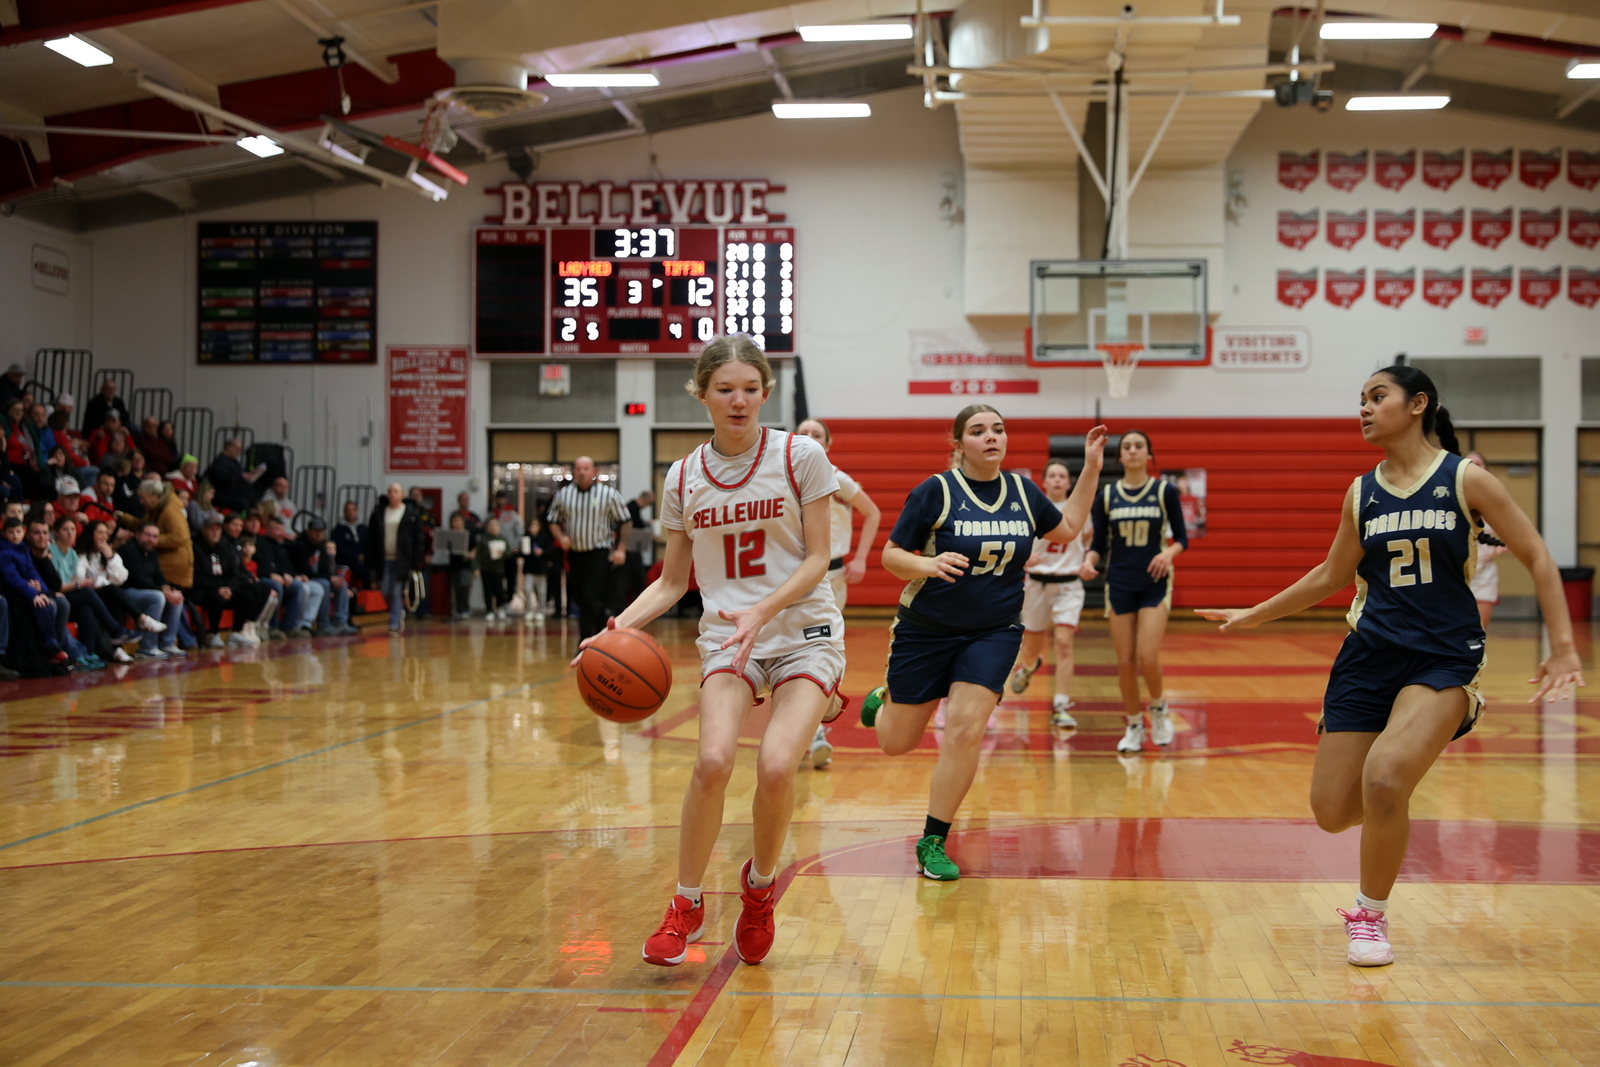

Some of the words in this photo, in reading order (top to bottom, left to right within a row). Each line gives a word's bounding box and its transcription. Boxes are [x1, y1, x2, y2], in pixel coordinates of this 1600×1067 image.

[502, 182, 769, 225] BELLEVUE
[229, 225, 267, 236] LAKE
[274, 224, 345, 236] DIVISION
[614, 228, 675, 258] 3:37
[559, 261, 612, 276] LADYRED
[618, 268, 651, 279] PERIOD
[662, 260, 705, 276] TIFFIN
[564, 277, 598, 307] 35
[628, 280, 642, 304] 3
[688, 277, 714, 306] 12
[607, 307, 640, 318] PLAYER
[641, 307, 663, 318] FOUL
[562, 317, 577, 341] 2
[698, 317, 714, 341] 0
[1225, 335, 1297, 348] VISITING
[1219, 350, 1303, 364] STUDENTS
[954, 520, 1030, 538] TORNADOES
[1118, 520, 1150, 548] 40
[1364, 509, 1457, 541] TORNADOES
[723, 528, 767, 581] 12
[971, 541, 1016, 577] 51
[1386, 537, 1433, 588] 21
